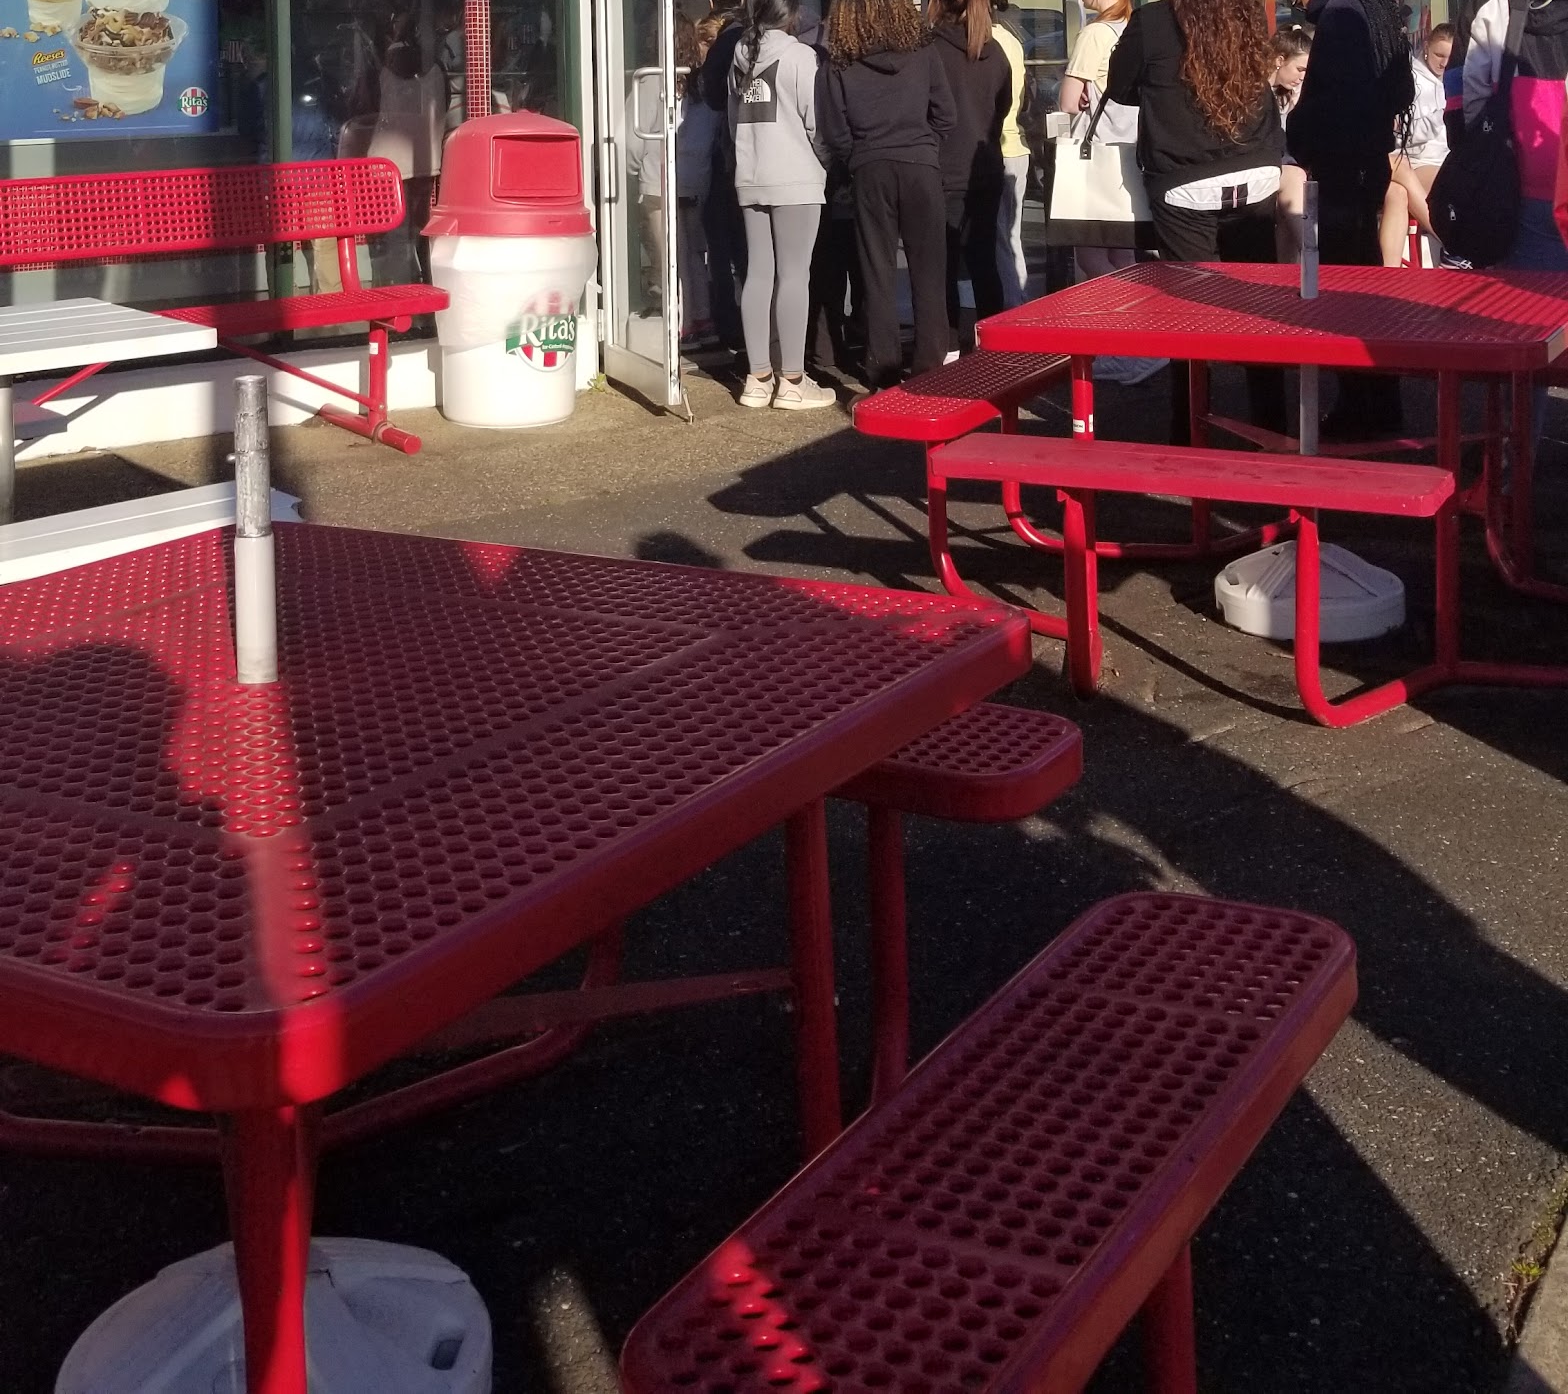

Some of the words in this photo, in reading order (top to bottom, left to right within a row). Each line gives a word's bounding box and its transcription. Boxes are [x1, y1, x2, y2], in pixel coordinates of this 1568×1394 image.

[36, 67, 72, 85] MUDSLIDE
[181, 96, 208, 107] Rita's
[519, 313, 576, 346] Rita's
